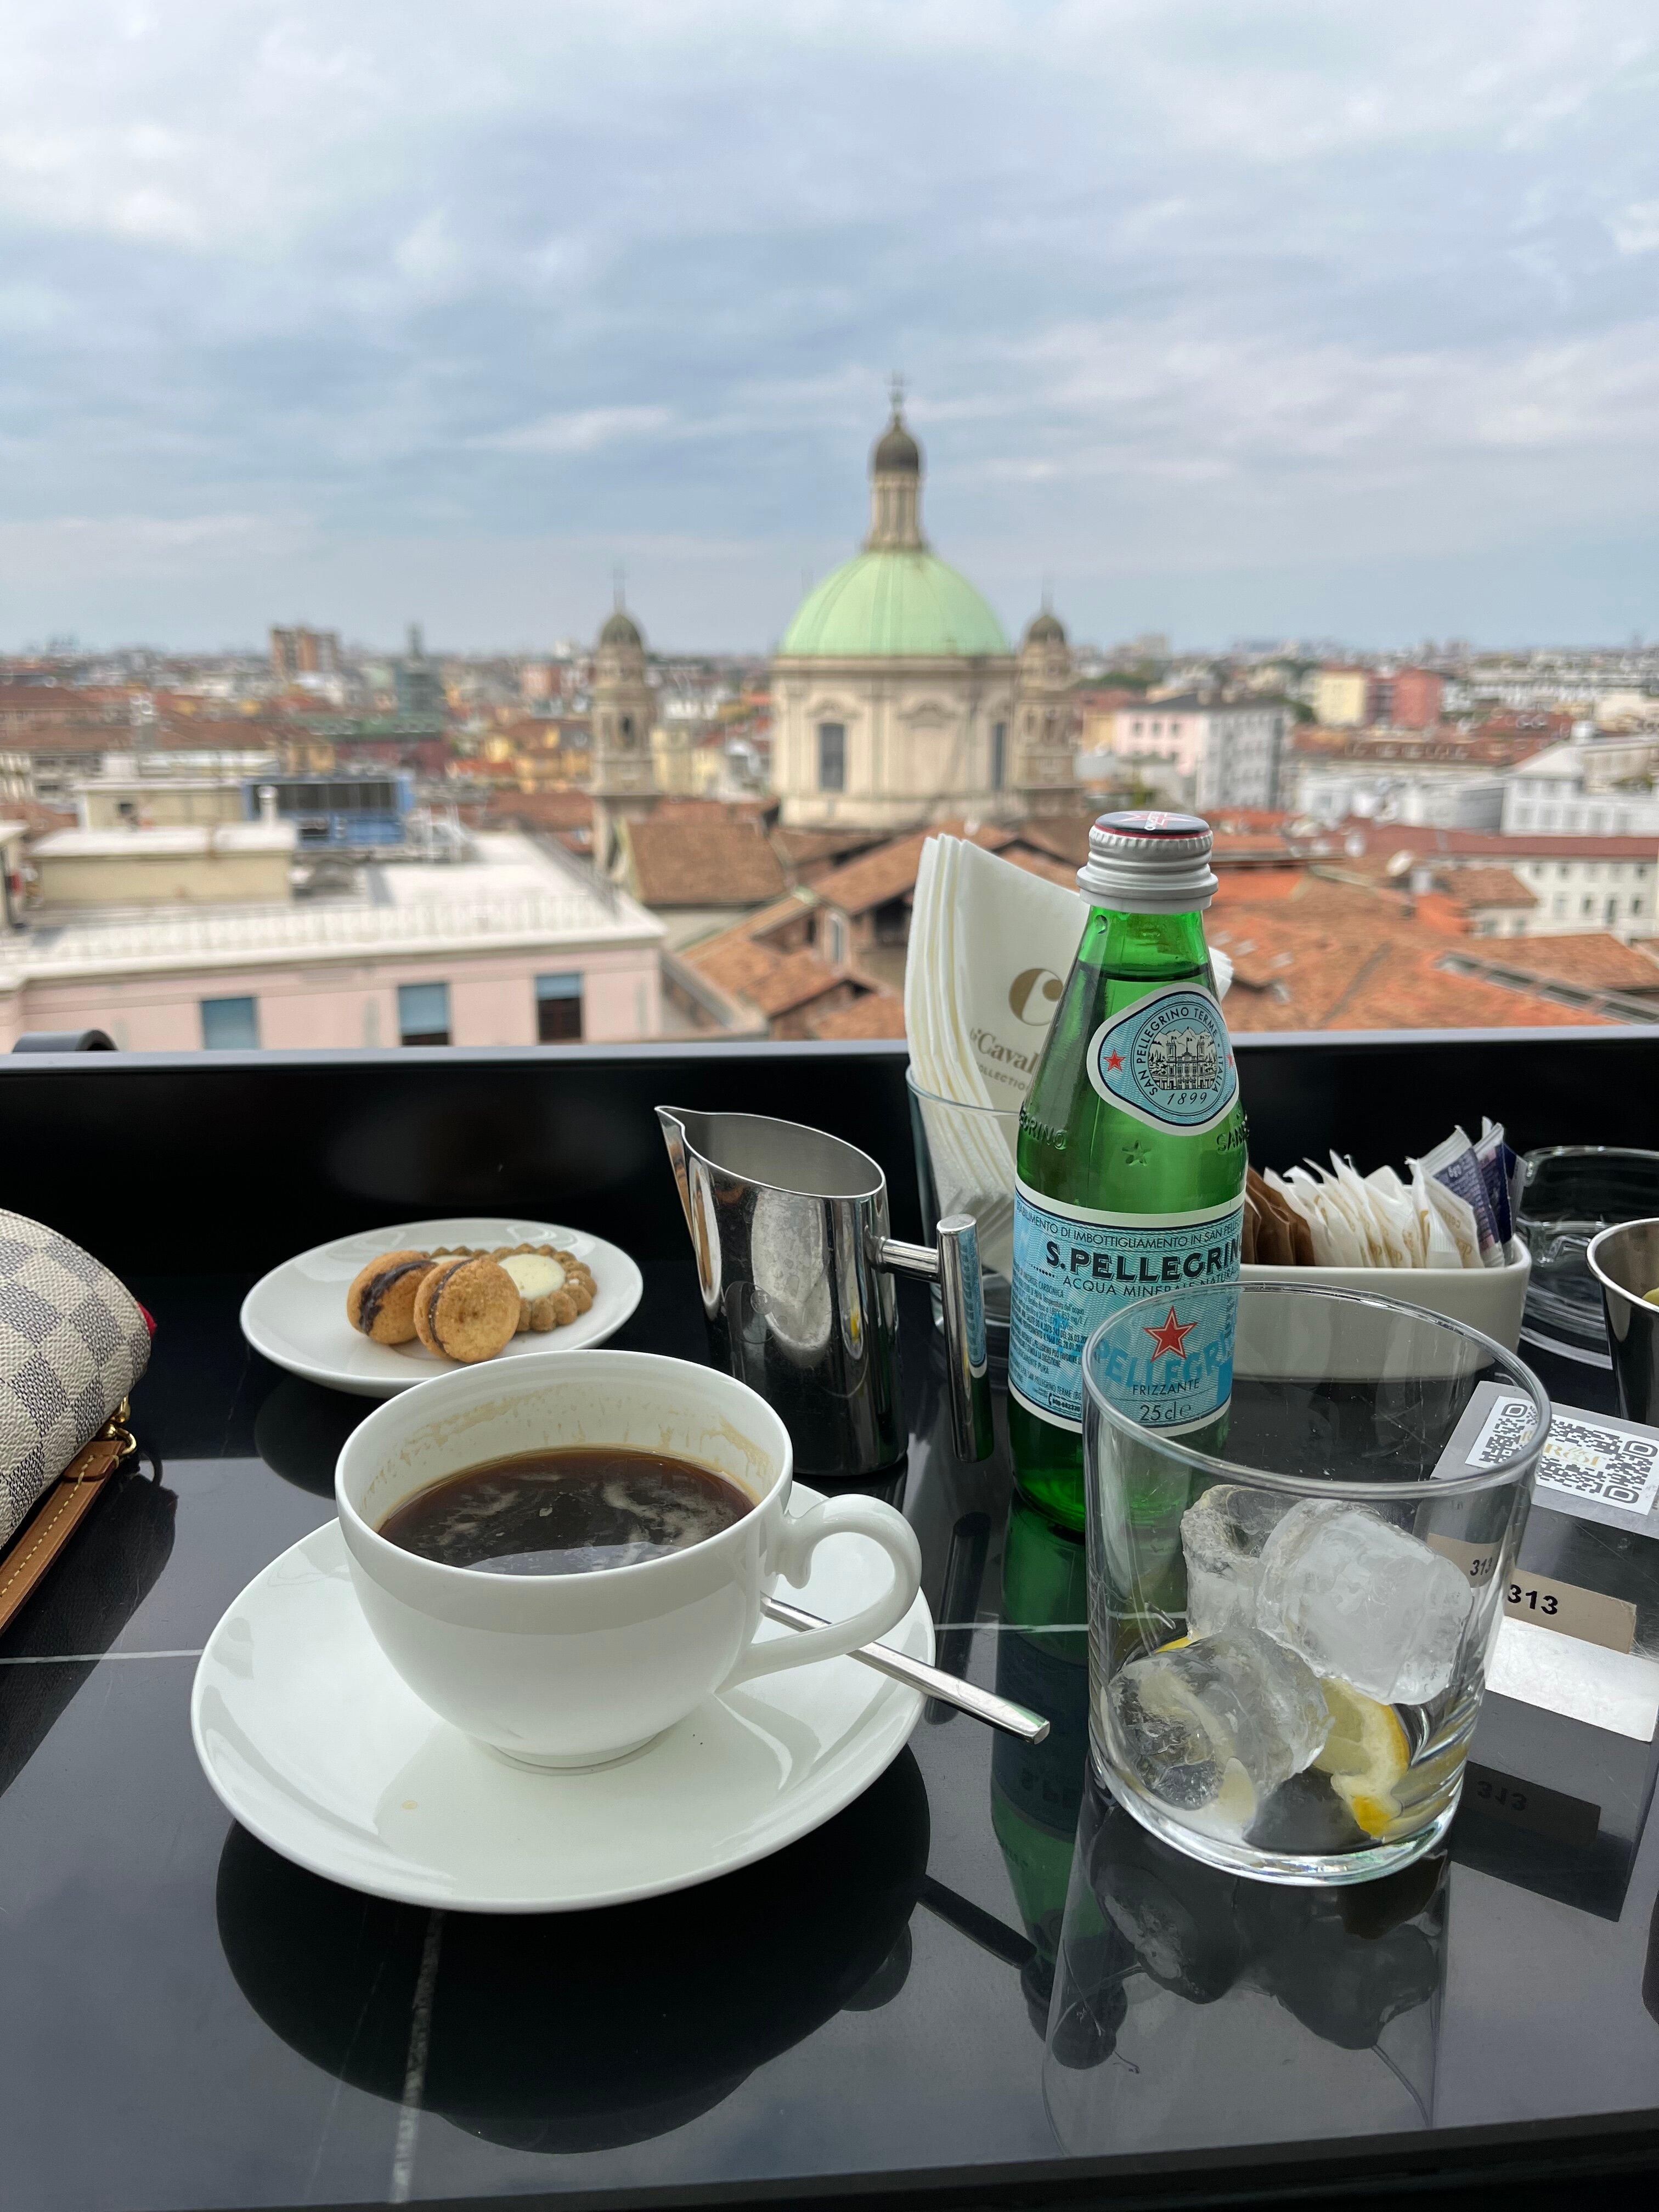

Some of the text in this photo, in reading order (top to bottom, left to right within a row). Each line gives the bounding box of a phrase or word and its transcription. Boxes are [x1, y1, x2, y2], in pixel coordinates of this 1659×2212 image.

[977, 1032, 1040, 1075] Caval
[1136, 1007, 1223, 1096] SAN PELLEGRINO TERME ITALIA
[978, 1064, 1031, 1091] OLLECTIO
[1166, 1092, 1207, 1105] 1899
[1060, 1227, 1070, 1238] DI
[1074, 1231, 1188, 1249] IMBOTTIGLIAMENTO
[1190, 1234, 1201, 1245] IN
[1205, 1228, 1222, 1242] SAN
[1224, 1219, 1239, 1233] PELLE
[1046, 1238, 1242, 1283] S.PELLEGRIN
[1063, 1276, 1116, 1295] ACQUA
[1201, 1266, 1237, 1285] NATURA
[1132, 1378, 1200, 1396] FRIZZANTE
[1470, 1559, 1493, 1576] 313
[1508, 1584, 1559, 1615] 313
